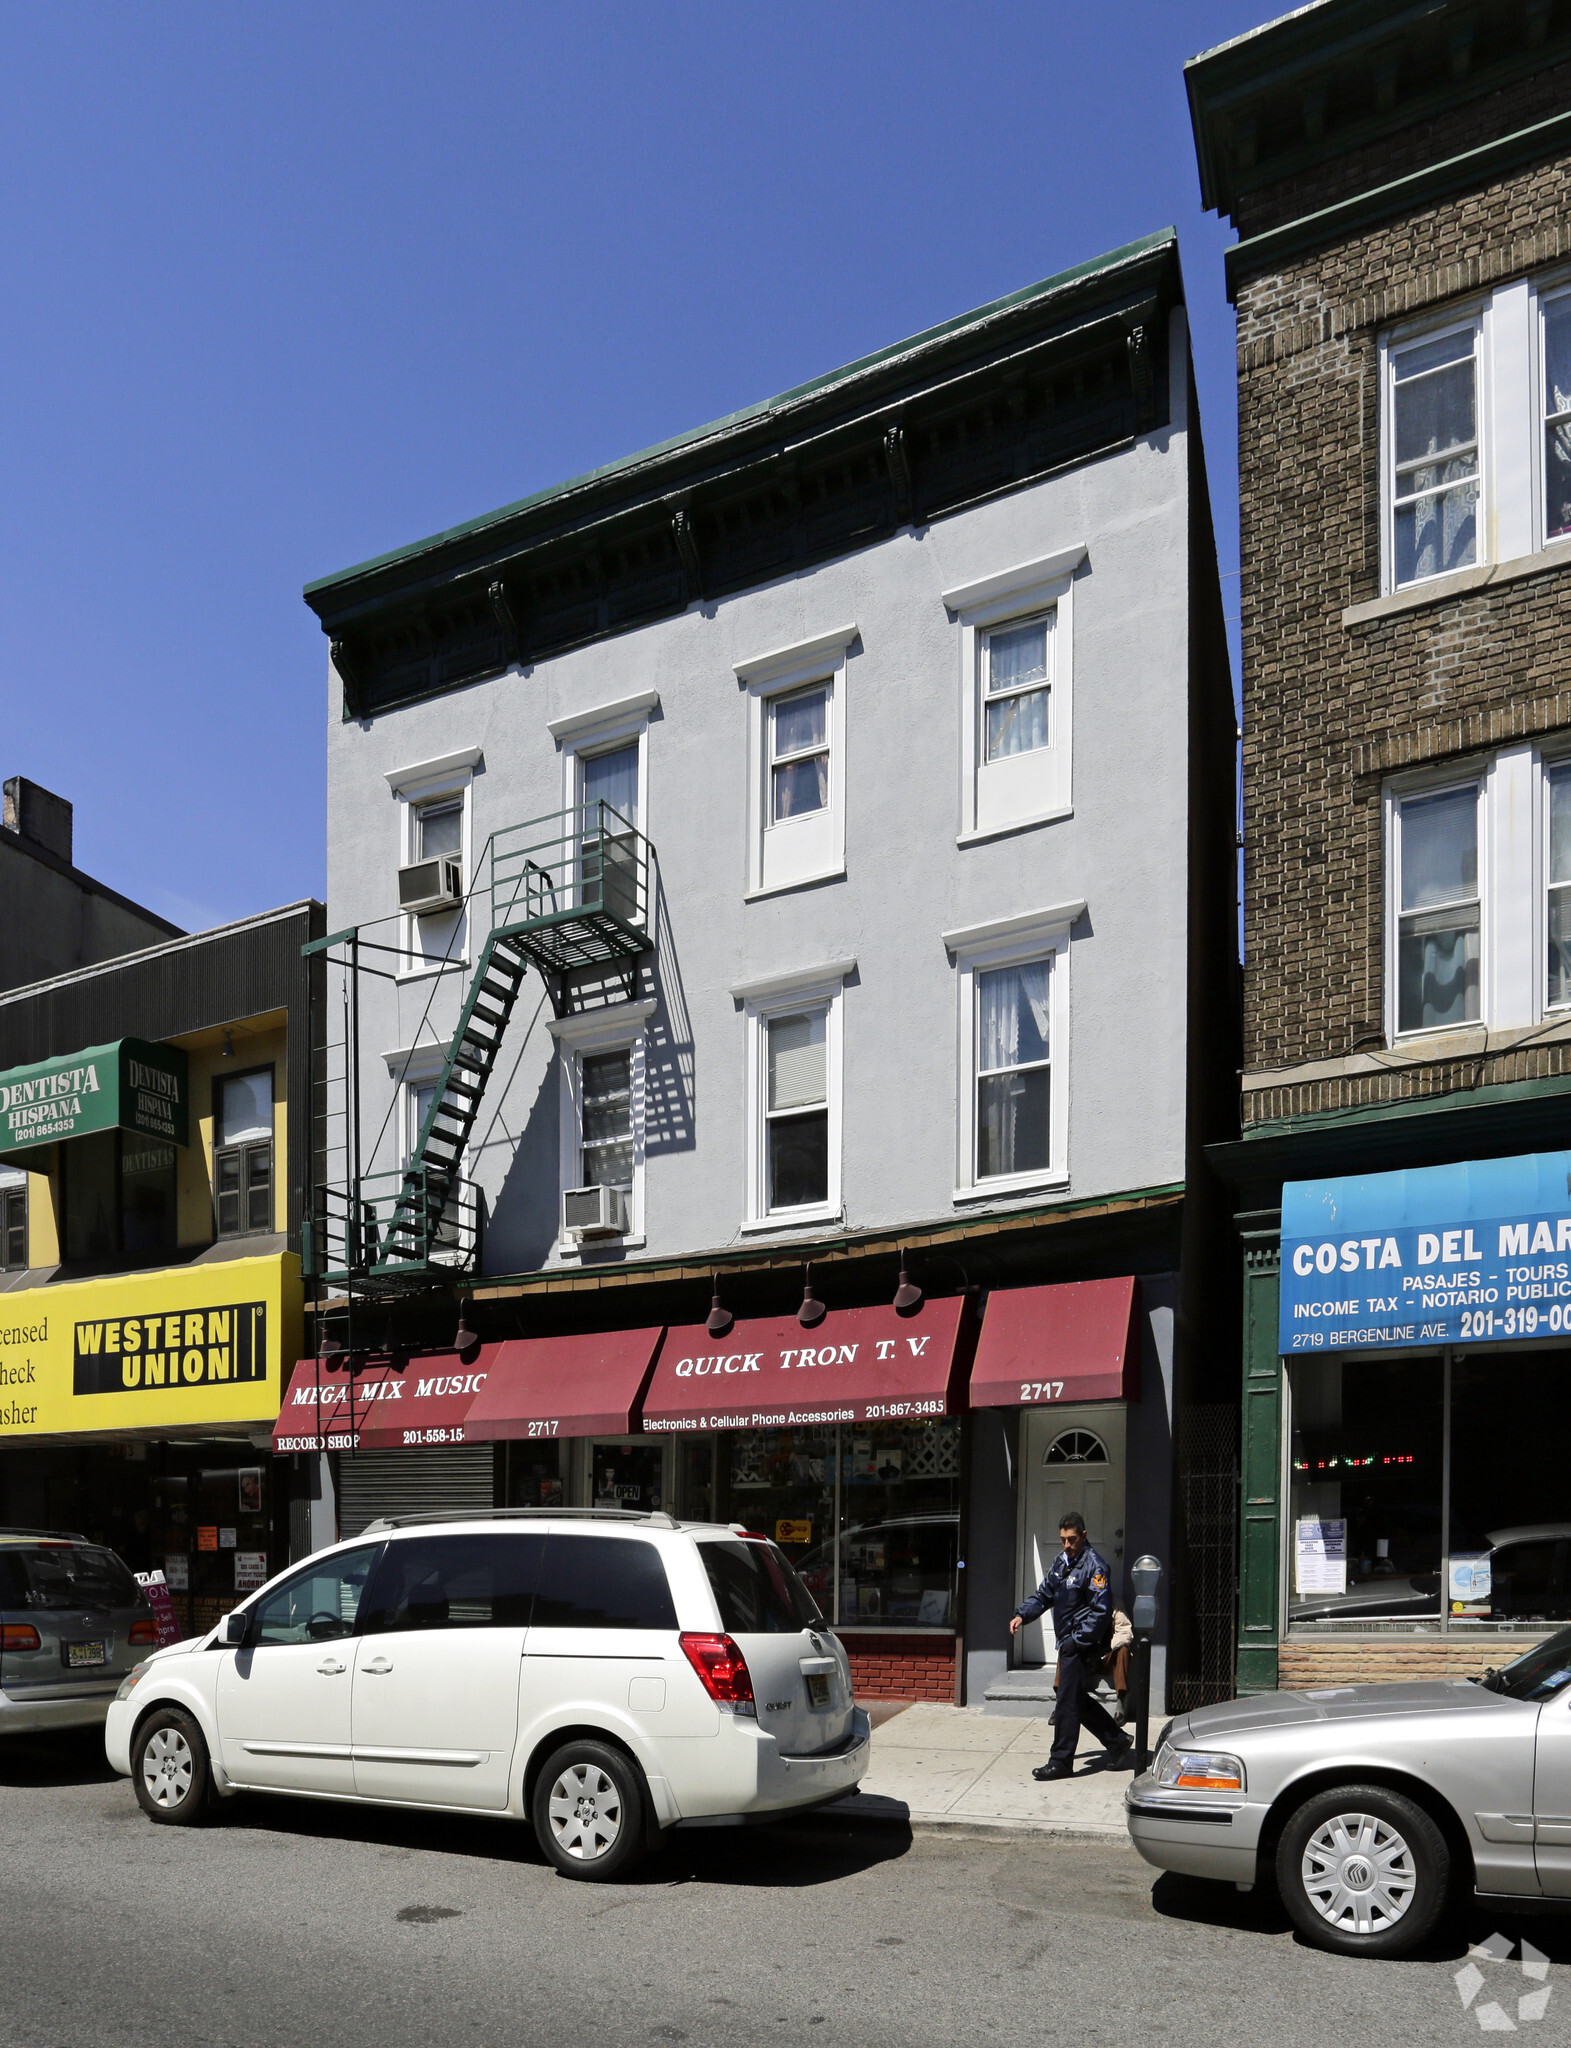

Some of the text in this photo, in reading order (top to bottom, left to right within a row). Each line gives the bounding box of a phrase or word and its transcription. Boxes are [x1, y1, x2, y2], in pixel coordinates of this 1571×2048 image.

[0, 1064, 100, 1113] DENTISTA
[129, 1059, 179, 1104] DENTISTA
[8, 1097, 82, 1130] HISPANA
[138, 1092, 172, 1120] HISPANA
[15, 1118, 74, 1142] (201) 865-1353
[122, 1146, 174, 1173] DENTISTAS
[1293, 1219, 1571, 1276] COSTA DEL MAR
[1403, 1271, 1481, 1291] PASAJES
[1506, 1263, 1568, 1283] TOURS
[1294, 1300, 1359, 1318] INCOME
[1367, 1296, 1398, 1313] TAX
[1422, 1288, 1499, 1308] NOTARIO
[1507, 1281, 1571, 1301] PUBLIC
[77, 1310, 230, 1355] WESTERN
[1293, 1333, 1324, 1347] 2719
[1330, 1325, 1414, 1345] BERGENLINE
[1420, 1323, 1449, 1337] AVE.
[122, 1347, 230, 1387] UNION
[675, 1336, 931, 1377] QUICK TRON T. V.
[291, 1374, 487, 1405] MEGA MIX MUSIC
[1020, 1382, 1064, 1400] 2717
[528, 1421, 558, 1436] 2717
[643, 1400, 944, 1430] Electronics & Cellular Phone Accessories 201-867-3485
[277, 1434, 360, 1451] RECORD SHOP
[616, 1486, 639, 1498] OPEN
